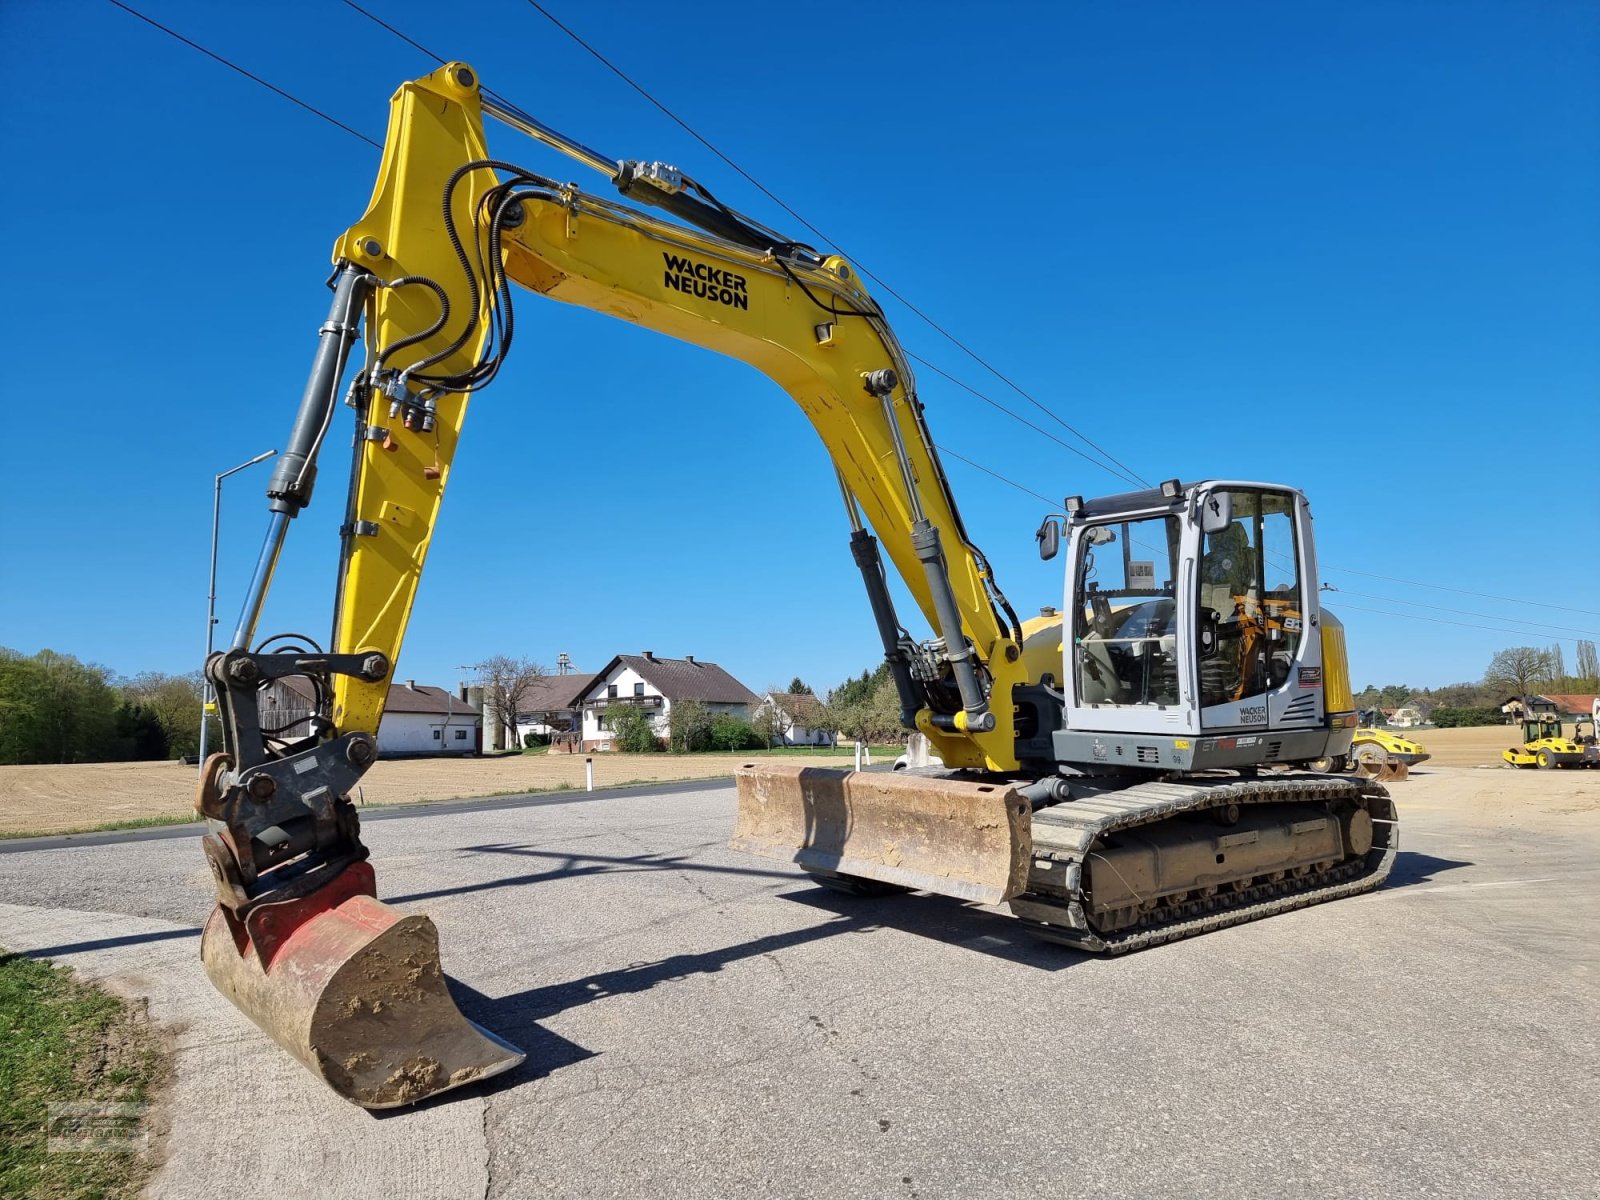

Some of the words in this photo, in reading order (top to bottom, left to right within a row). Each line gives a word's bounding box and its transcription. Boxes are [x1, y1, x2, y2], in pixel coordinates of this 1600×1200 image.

[662, 252, 748, 293] WACKER
[664, 271, 748, 311] NEUSON
[1240, 706, 1266, 716] WACKER
[1240, 714, 1267, 724] NEUSON
